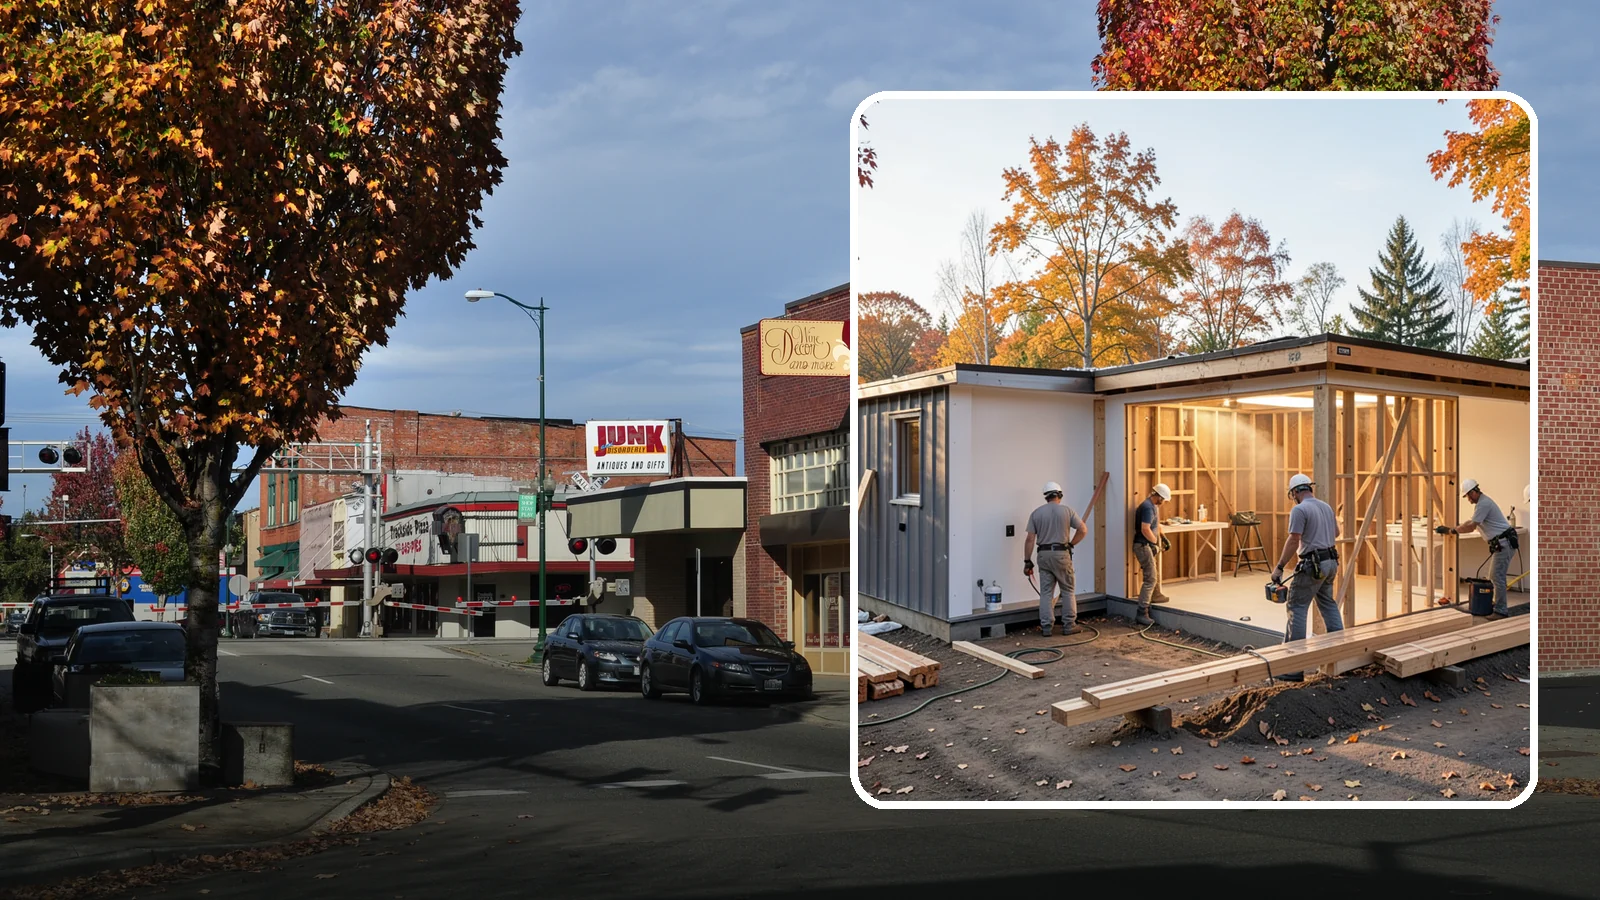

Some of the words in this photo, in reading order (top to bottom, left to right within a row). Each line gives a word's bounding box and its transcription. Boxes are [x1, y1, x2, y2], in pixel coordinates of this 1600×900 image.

[595, 425, 664, 457] JUNK
[607, 446, 646, 454] DISORDERLY
[596, 461, 628, 470] ANTIQUES
[631, 461, 644, 470] AND
[647, 460, 665, 470] GIFTS
[414, 519, 429, 535] Pizza
